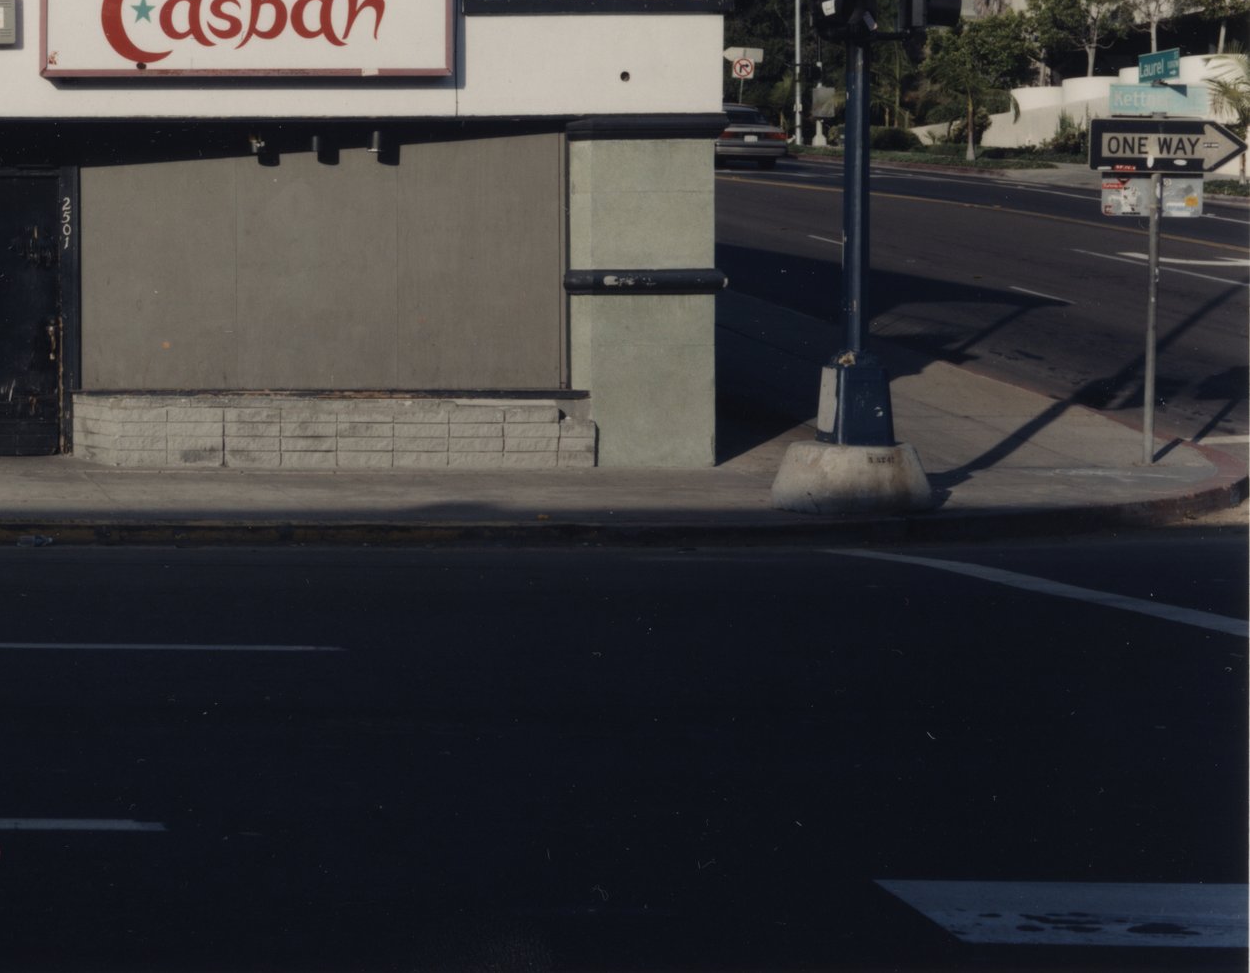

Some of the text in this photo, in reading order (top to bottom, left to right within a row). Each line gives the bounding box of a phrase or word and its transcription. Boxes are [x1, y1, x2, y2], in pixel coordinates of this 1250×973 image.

[1139, 58, 1164, 78] Laurel
[1114, 90, 1171, 107] Kett
[1107, 136, 1201, 155] ONE WAY
[61, 197, 71, 250] 2501
